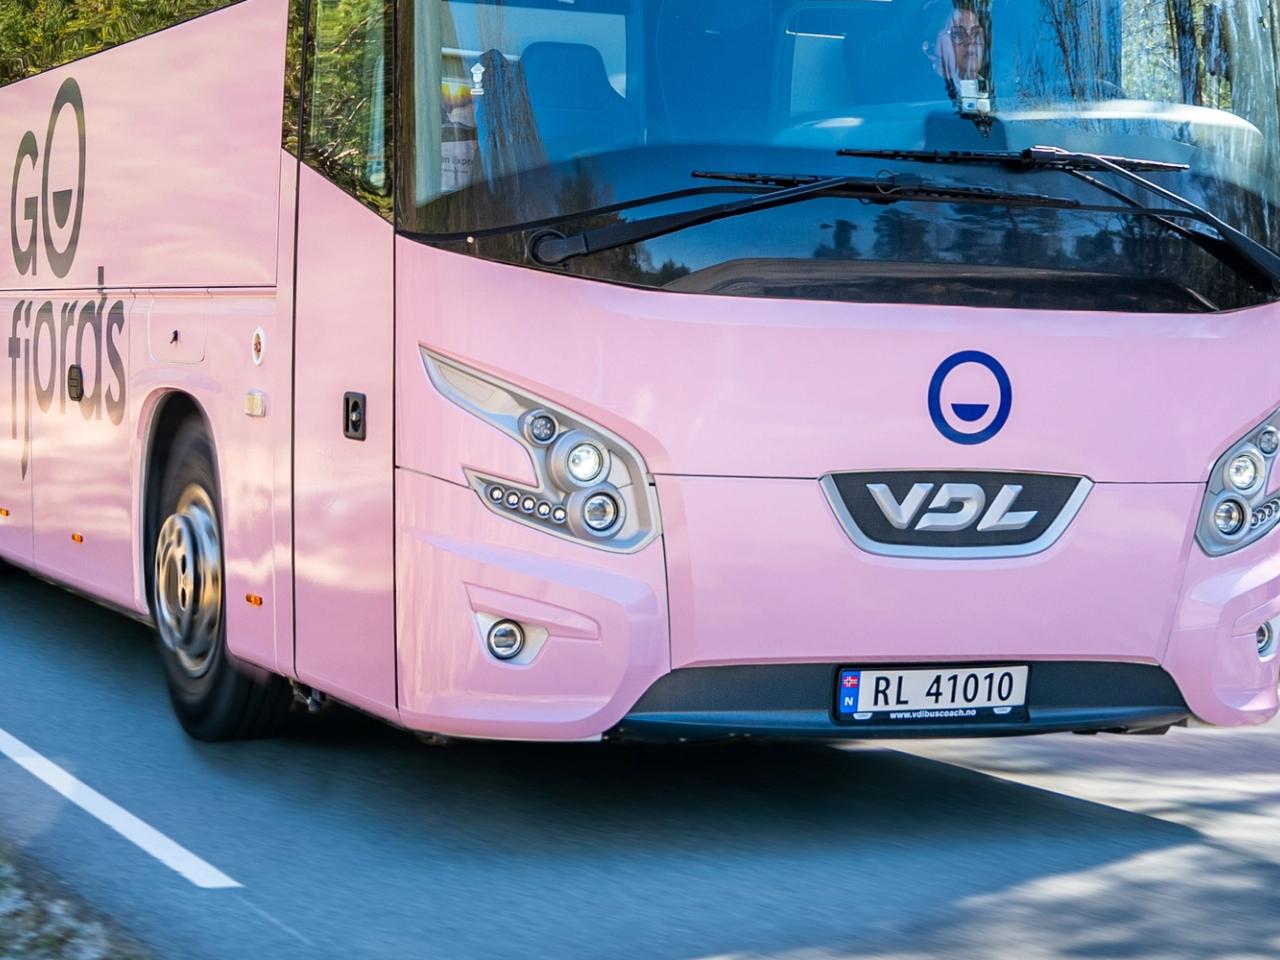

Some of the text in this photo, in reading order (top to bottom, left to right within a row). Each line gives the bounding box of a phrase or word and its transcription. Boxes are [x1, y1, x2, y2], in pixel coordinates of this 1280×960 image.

[11, 77, 86, 279] GO
[8, 266, 127, 481] fjords
[866, 483, 1039, 532] VDL
[844, 696, 854, 707] N
[873, 672, 1014, 706] RL 41010
[889, 708, 977, 720] www.vdlbuscoach.no
